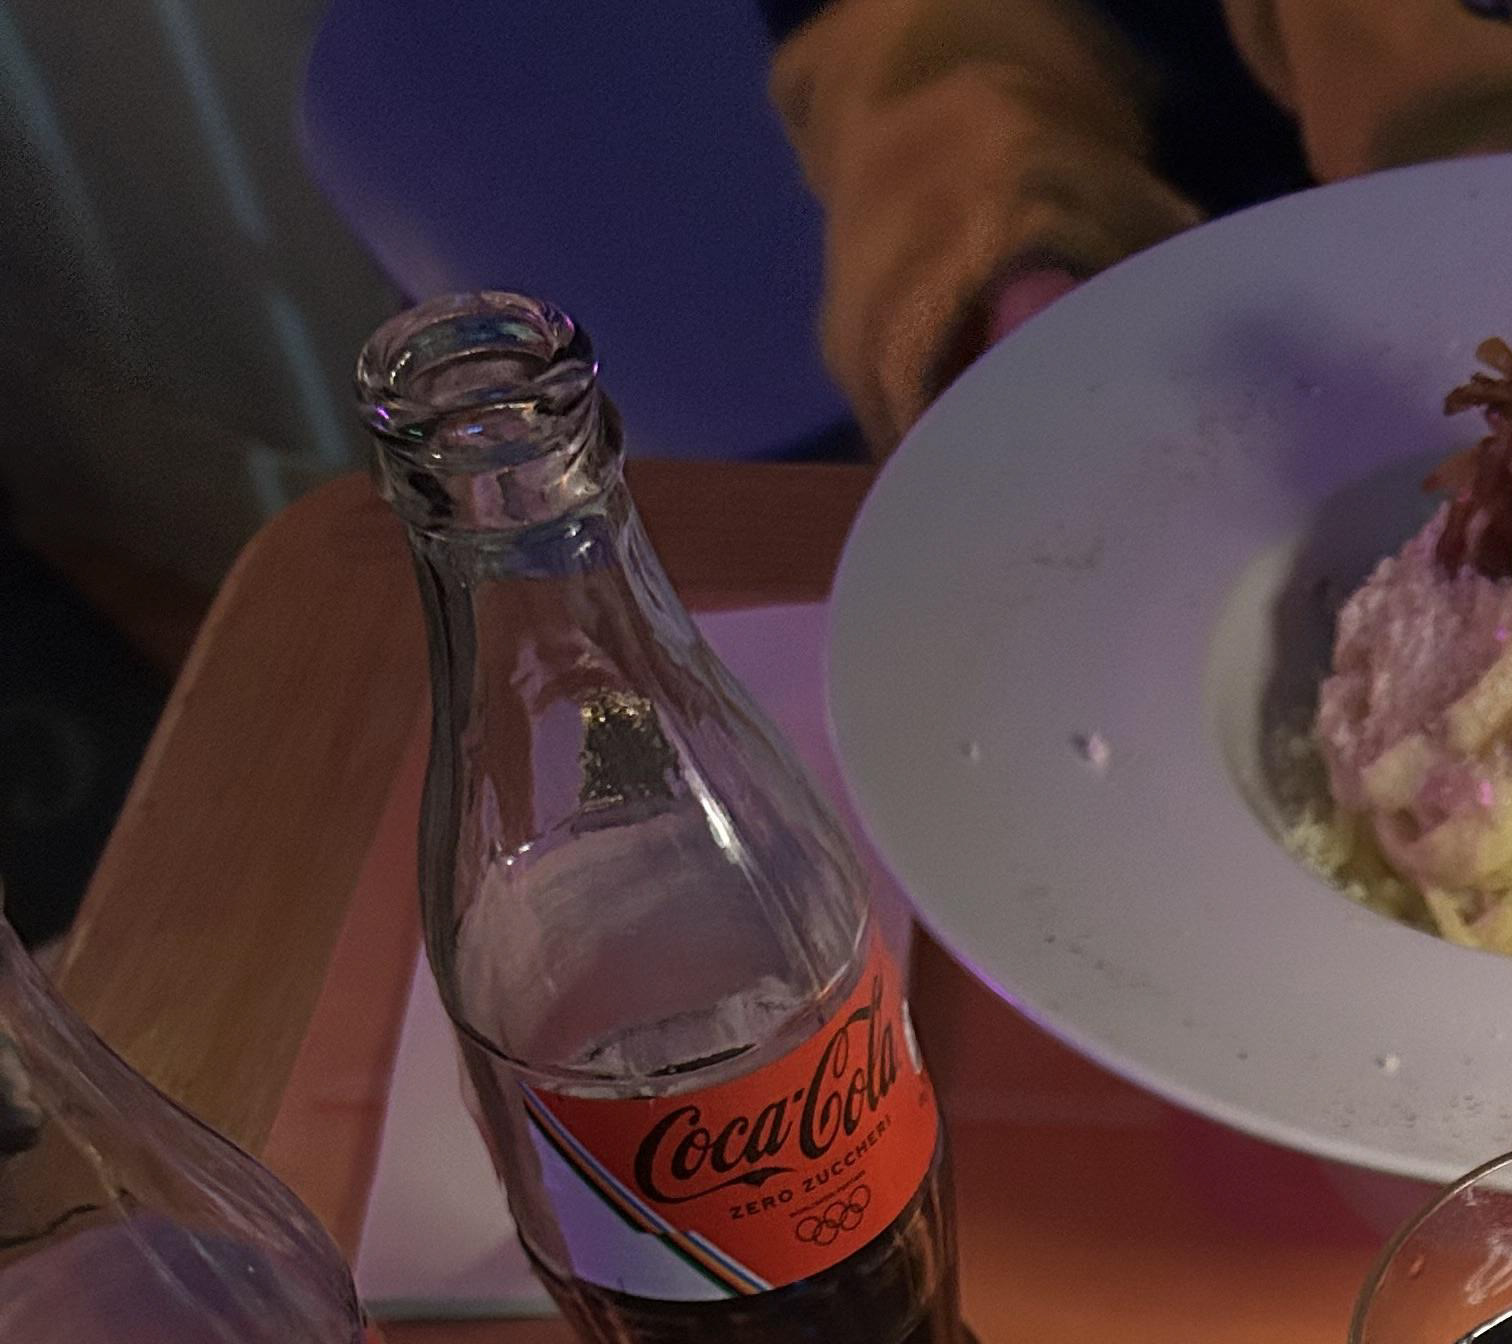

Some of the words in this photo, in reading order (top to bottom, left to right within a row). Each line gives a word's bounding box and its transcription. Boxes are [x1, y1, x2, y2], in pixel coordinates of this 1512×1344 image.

[634, 974, 897, 1204] Coca-Cola
[730, 1187, 793, 1221] ZERO
[803, 1115, 892, 1195] ZUCCHERI
